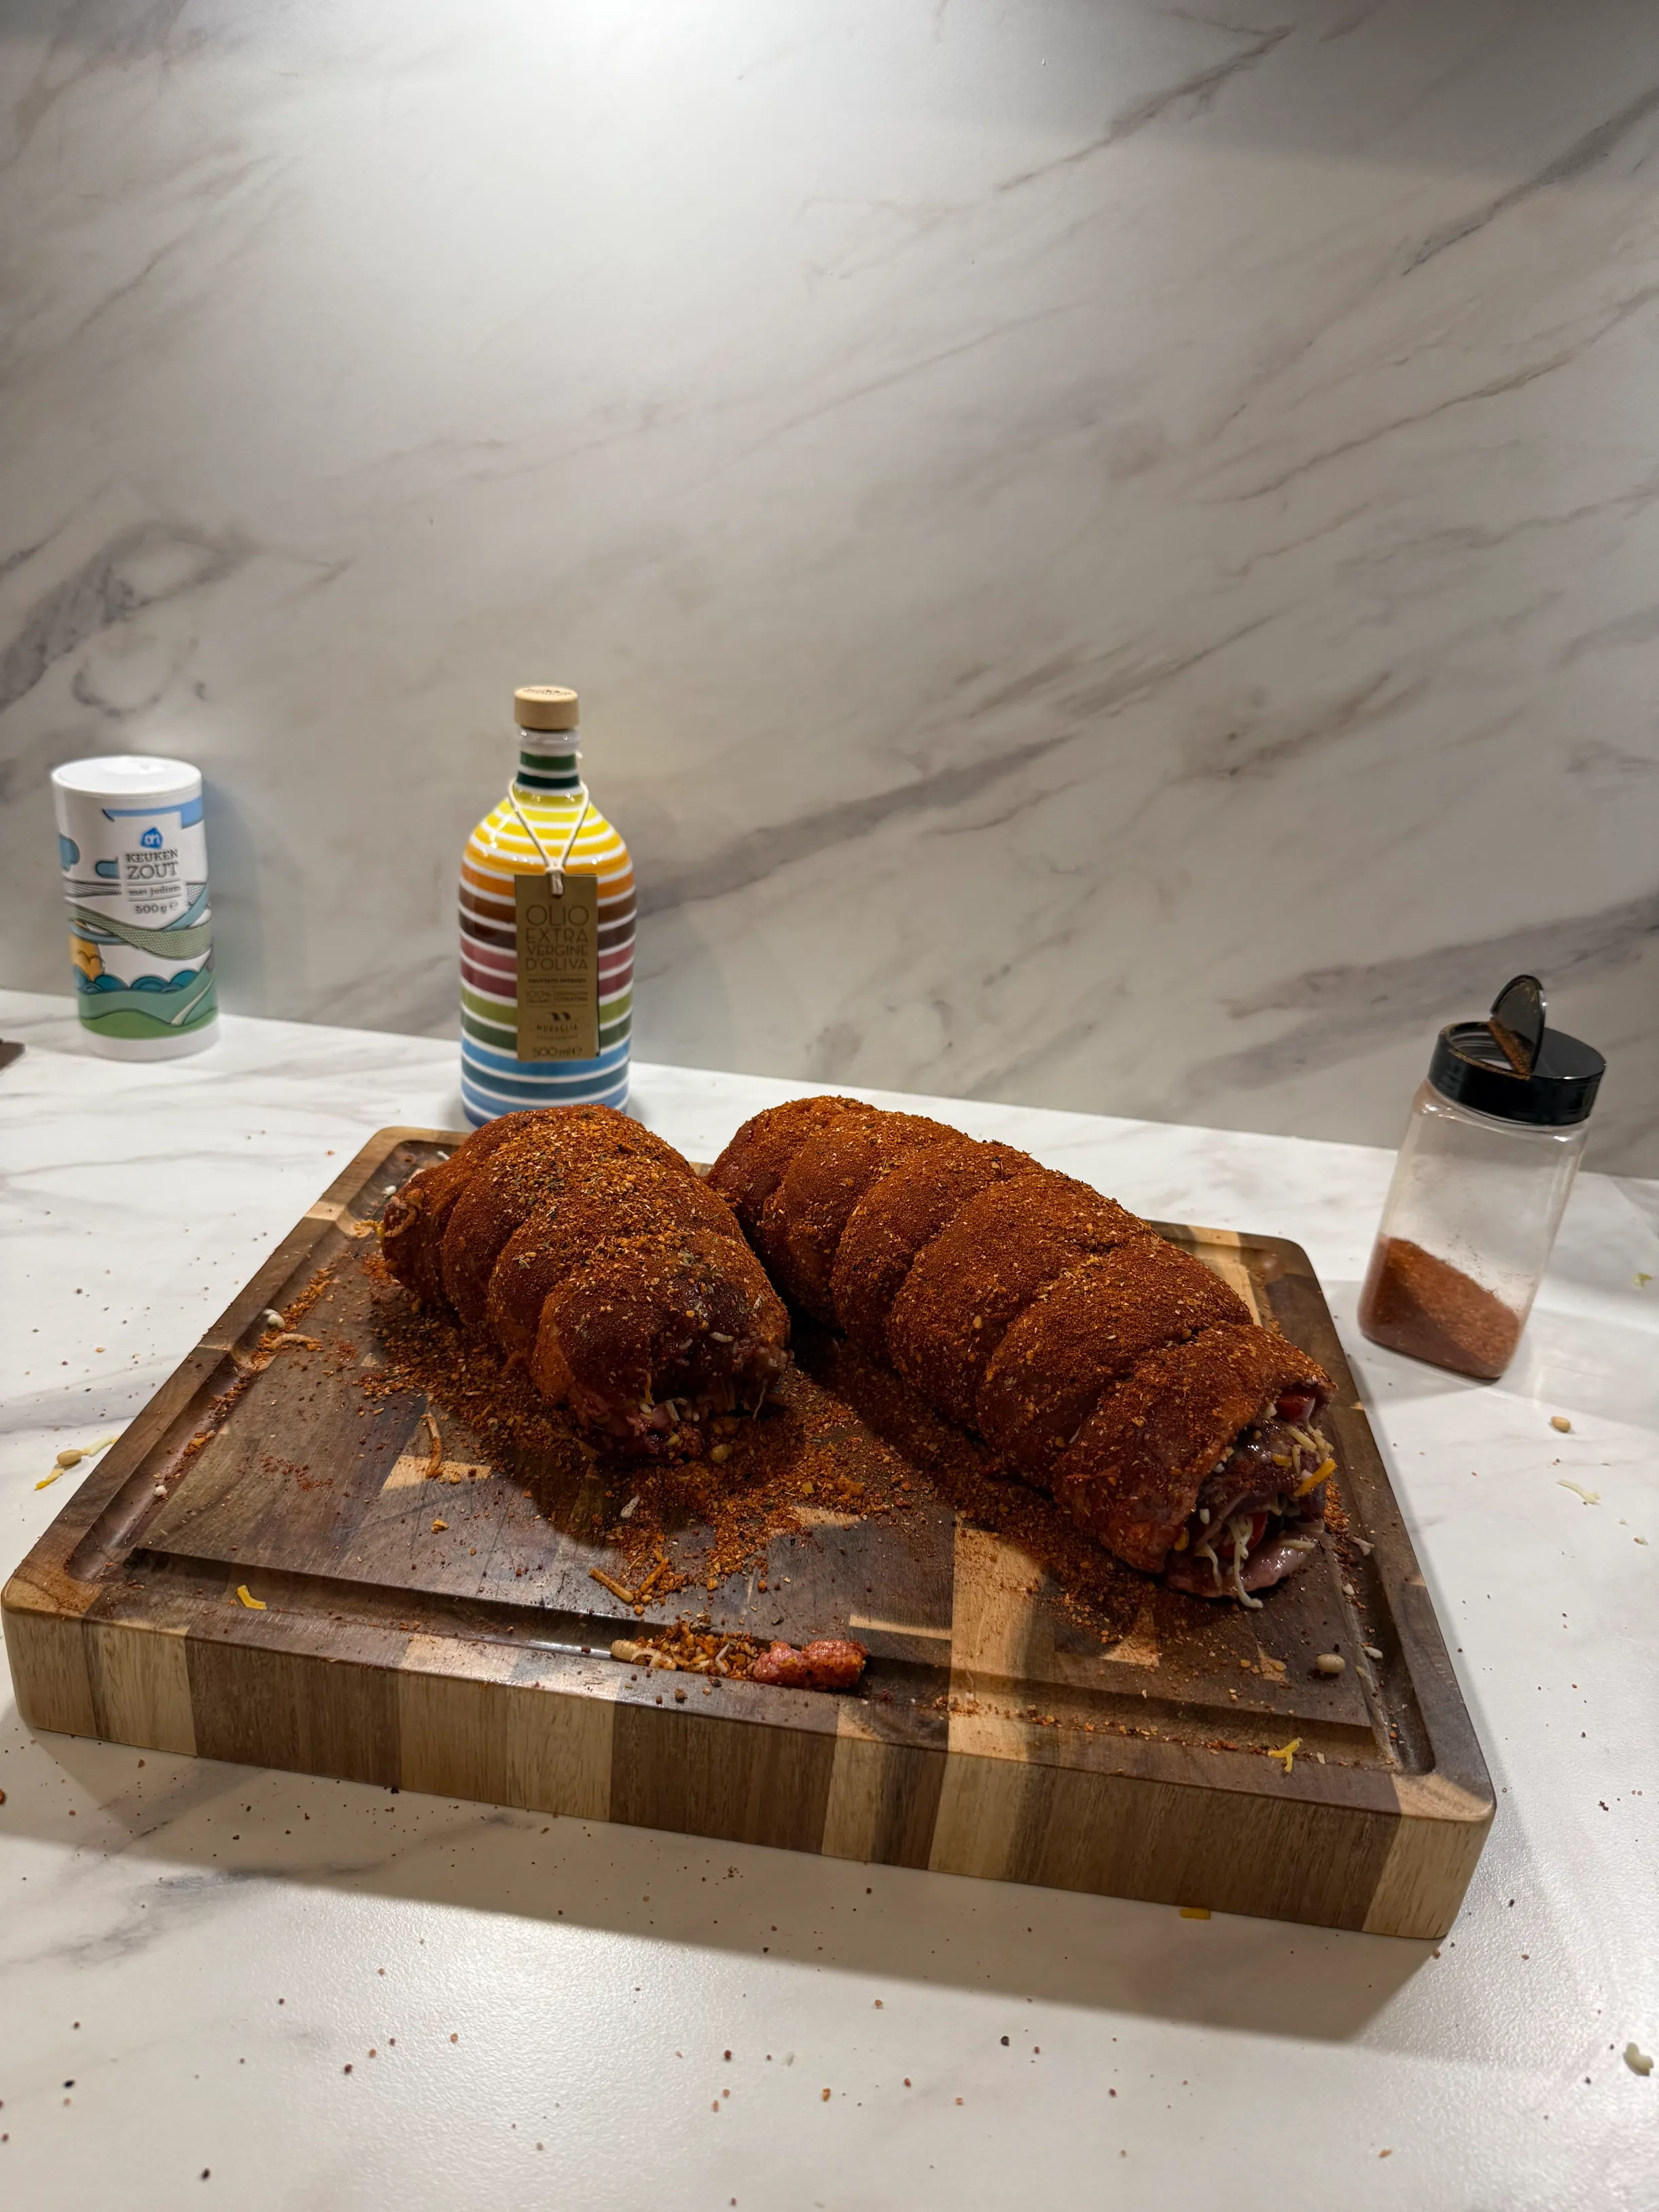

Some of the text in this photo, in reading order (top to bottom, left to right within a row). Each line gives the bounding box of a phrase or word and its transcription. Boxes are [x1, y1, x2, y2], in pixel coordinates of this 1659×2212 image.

[126, 849, 178, 863] KEUKEN
[127, 861, 179, 880] ZOUT
[149, 885, 181, 897] jodium
[526, 904, 589, 927] OLIO
[527, 928, 588, 944] EXTRA
[527, 944, 588, 957] VERGINE
[527, 958, 588, 971] D'OLIVA
[537, 1024, 579, 1033] MURAGLIA
[533, 1046, 558, 1058] 500
